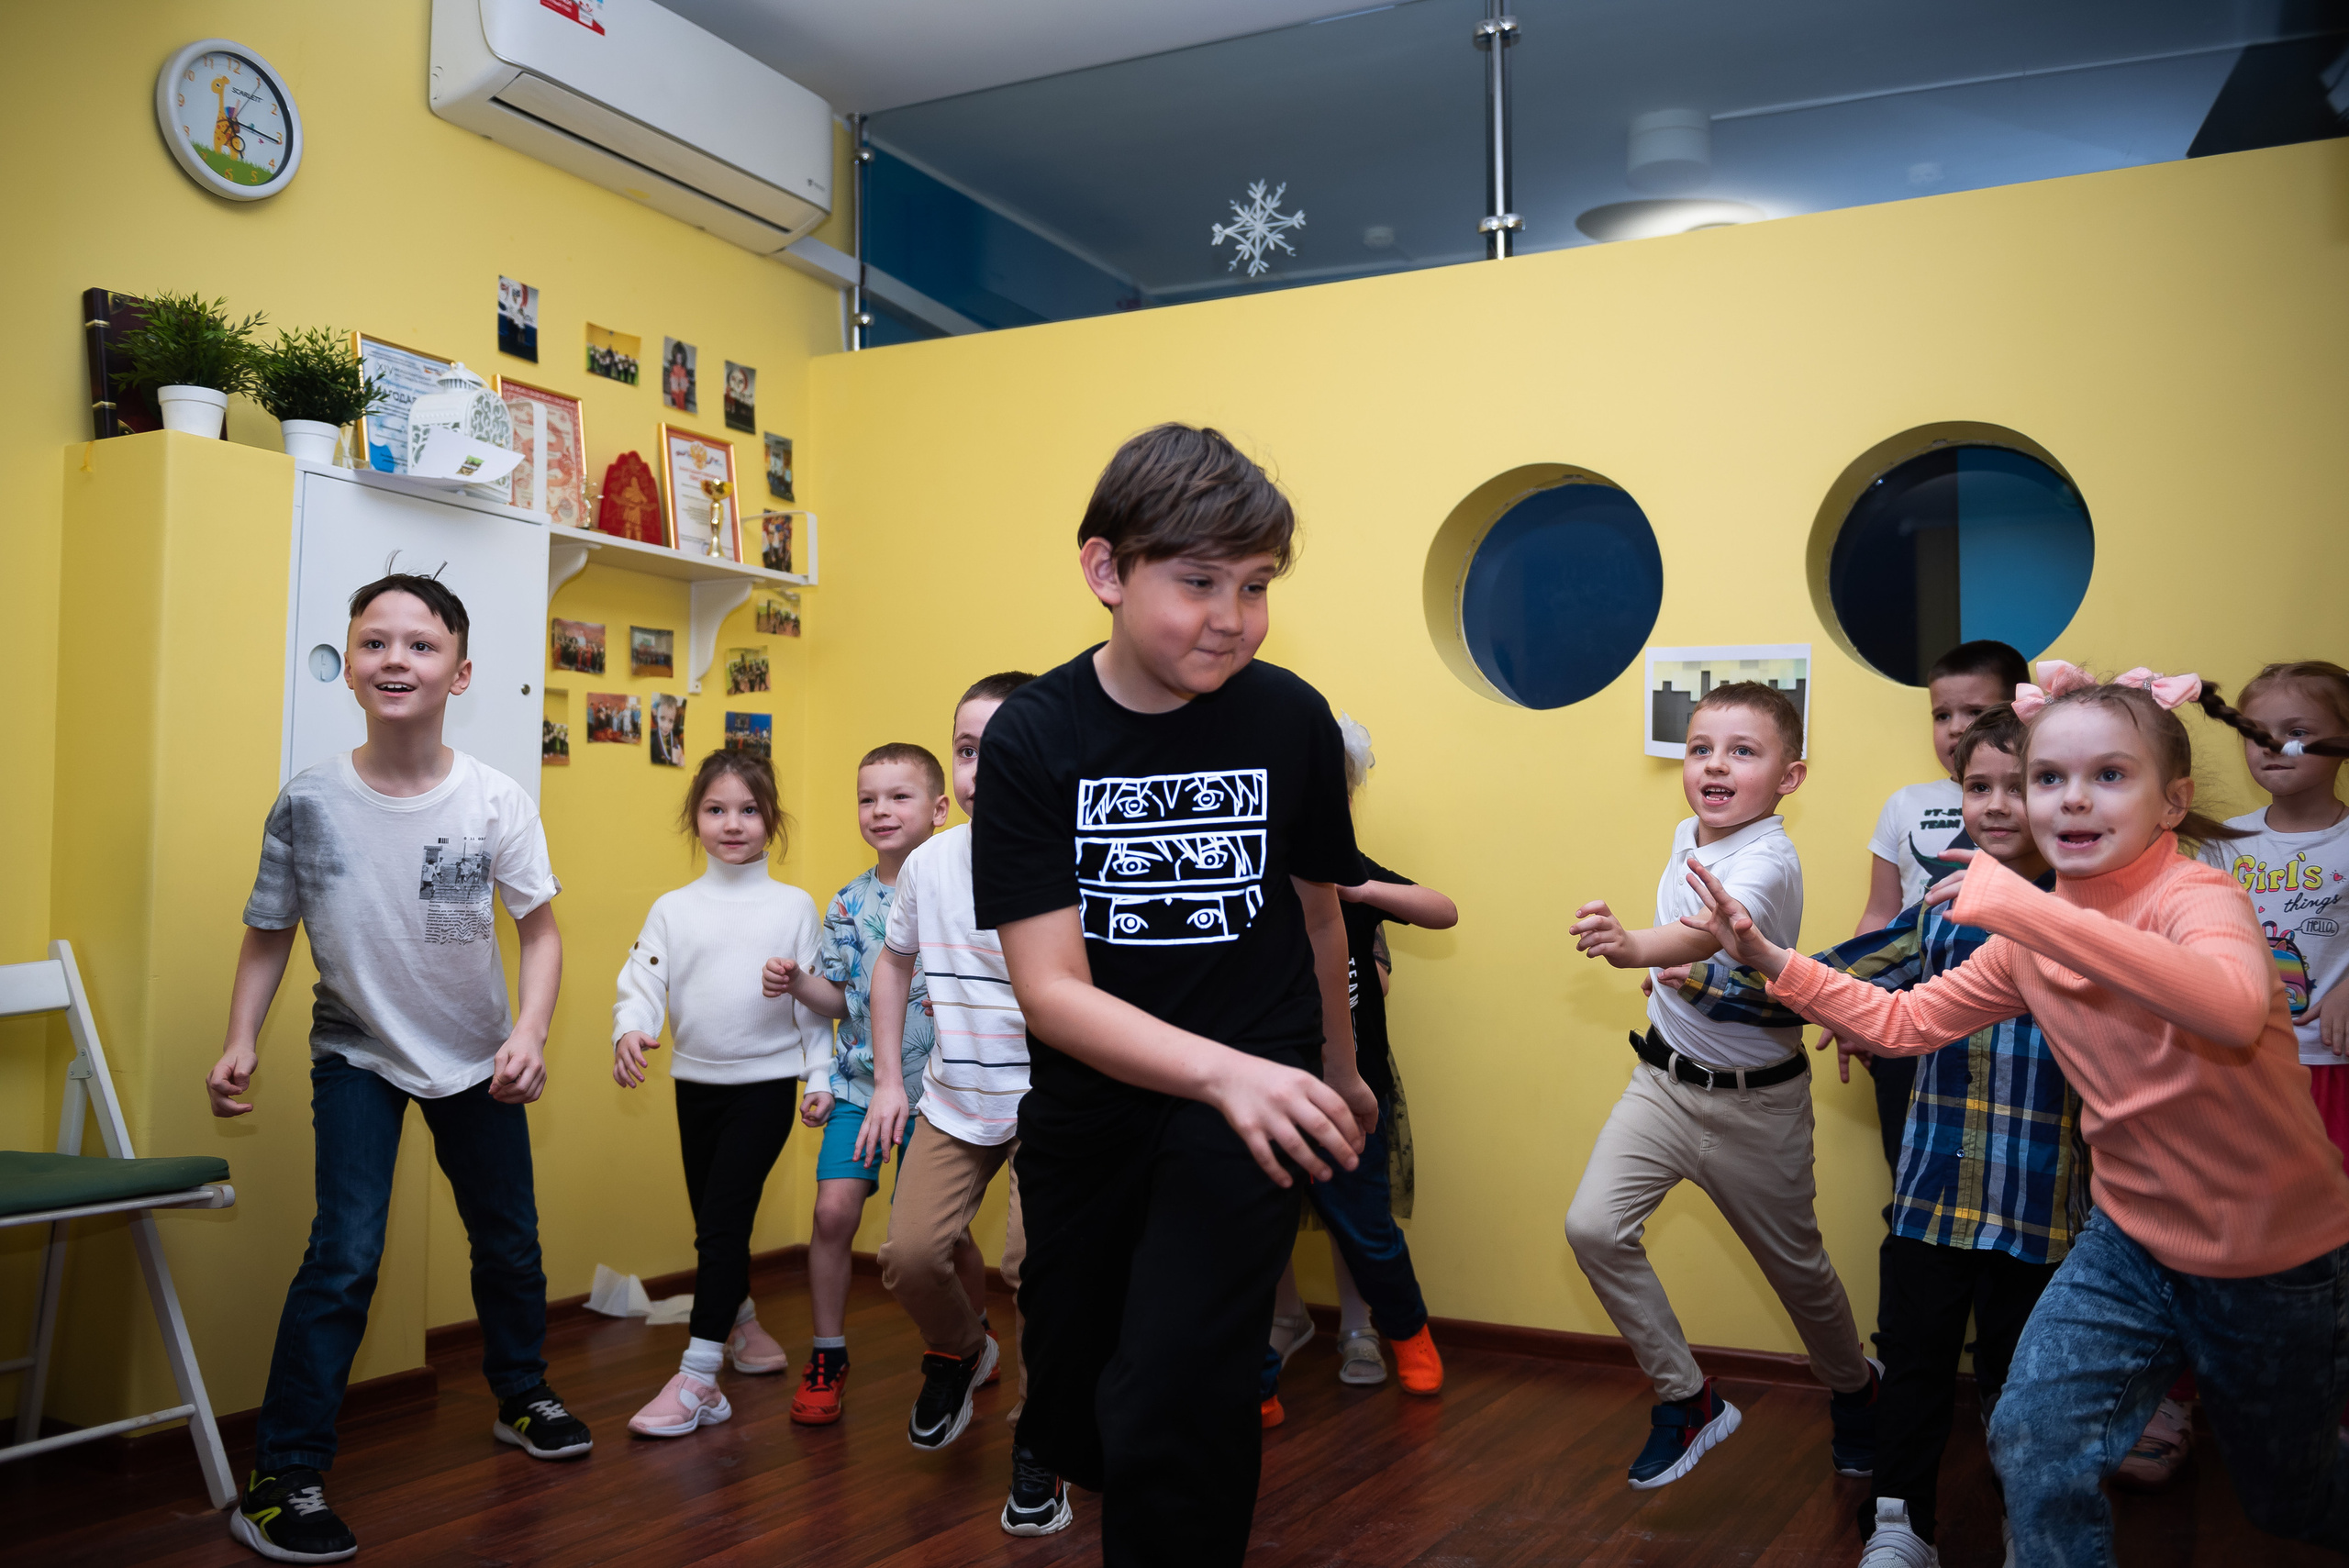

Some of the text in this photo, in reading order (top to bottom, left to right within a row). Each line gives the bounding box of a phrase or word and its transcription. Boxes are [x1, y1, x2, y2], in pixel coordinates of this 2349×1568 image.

[202, 55, 215, 70] 11
[227, 58, 241, 75] 12
[183, 69, 195, 83] 10
[255, 76, 261, 89] 1
[177, 93, 185, 107] 9
[230, 86, 263, 103] SCARLETT
[271, 103, 278, 117] 2
[276, 131, 283, 146] 3
[268, 158, 275, 169] 4
[224, 168, 233, 182] 6
[250, 171, 258, 183] 5
[1920, 819, 1961, 829] TEAM
[2232, 851, 2323, 894] Girl's
[2284, 893, 2342, 914] things
[1348, 957, 1358, 1009] TEAM
